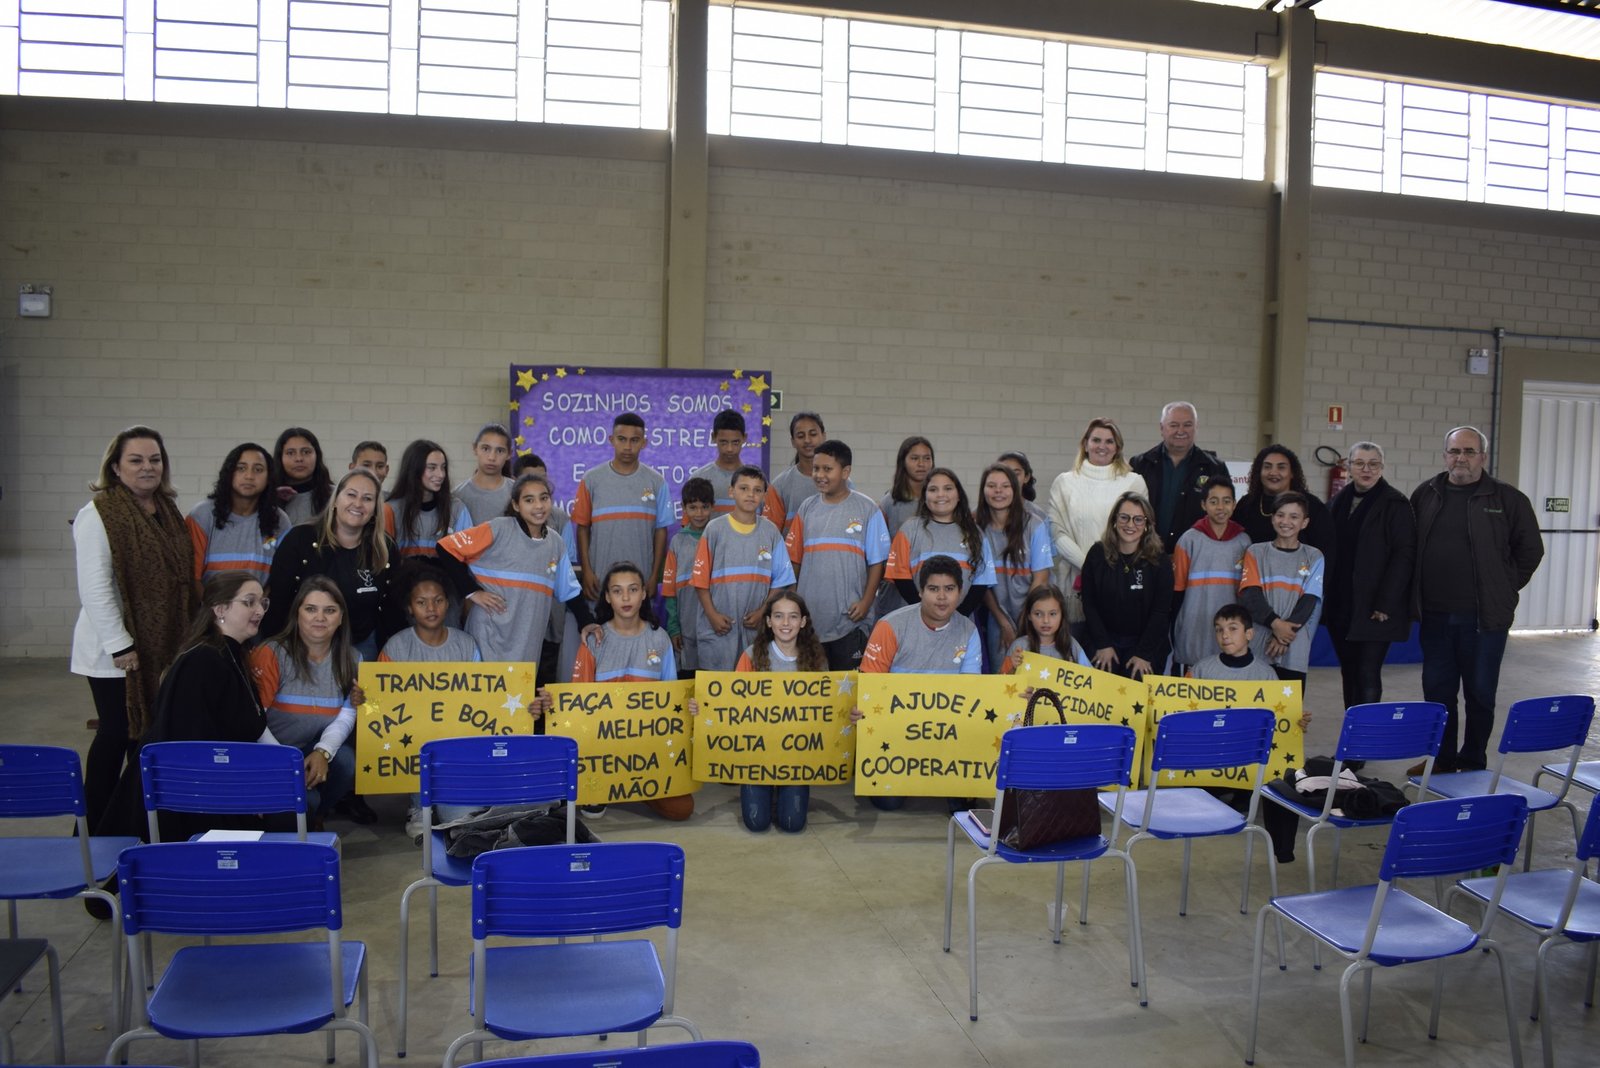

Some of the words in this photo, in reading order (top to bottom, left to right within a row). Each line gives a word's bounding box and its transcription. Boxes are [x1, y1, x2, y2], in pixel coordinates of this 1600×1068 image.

[542, 392, 650, 412] SOZINHOS
[667, 394, 732, 412] SOMOS
[549, 427, 607, 446] COMO
[375, 672, 507, 693] TRANSMITA
[708, 681, 722, 697] O
[731, 679, 773, 698] QUE
[783, 676, 832, 697] VOCÊ
[1056, 668, 1093, 689] PEÇA
[559, 692, 612, 715] FAÇA
[626, 691, 671, 710] SEU
[1155, 683, 1237, 702] ACENDER
[1253, 688, 1265, 702] A
[368, 703, 412, 738] PAZ
[431, 702, 444, 722] E
[714, 705, 833, 725] TRANSMITE
[597, 717, 684, 739] MELHOR
[905, 721, 958, 740] SEJA
[707, 734, 766, 751] VOLTA
[781, 732, 824, 751] COM
[577, 752, 659, 774] STENDA
[674, 748, 687, 767] A
[861, 756, 998, 780] COOPERATIV
[708, 763, 848, 781] INTENSIDADE
